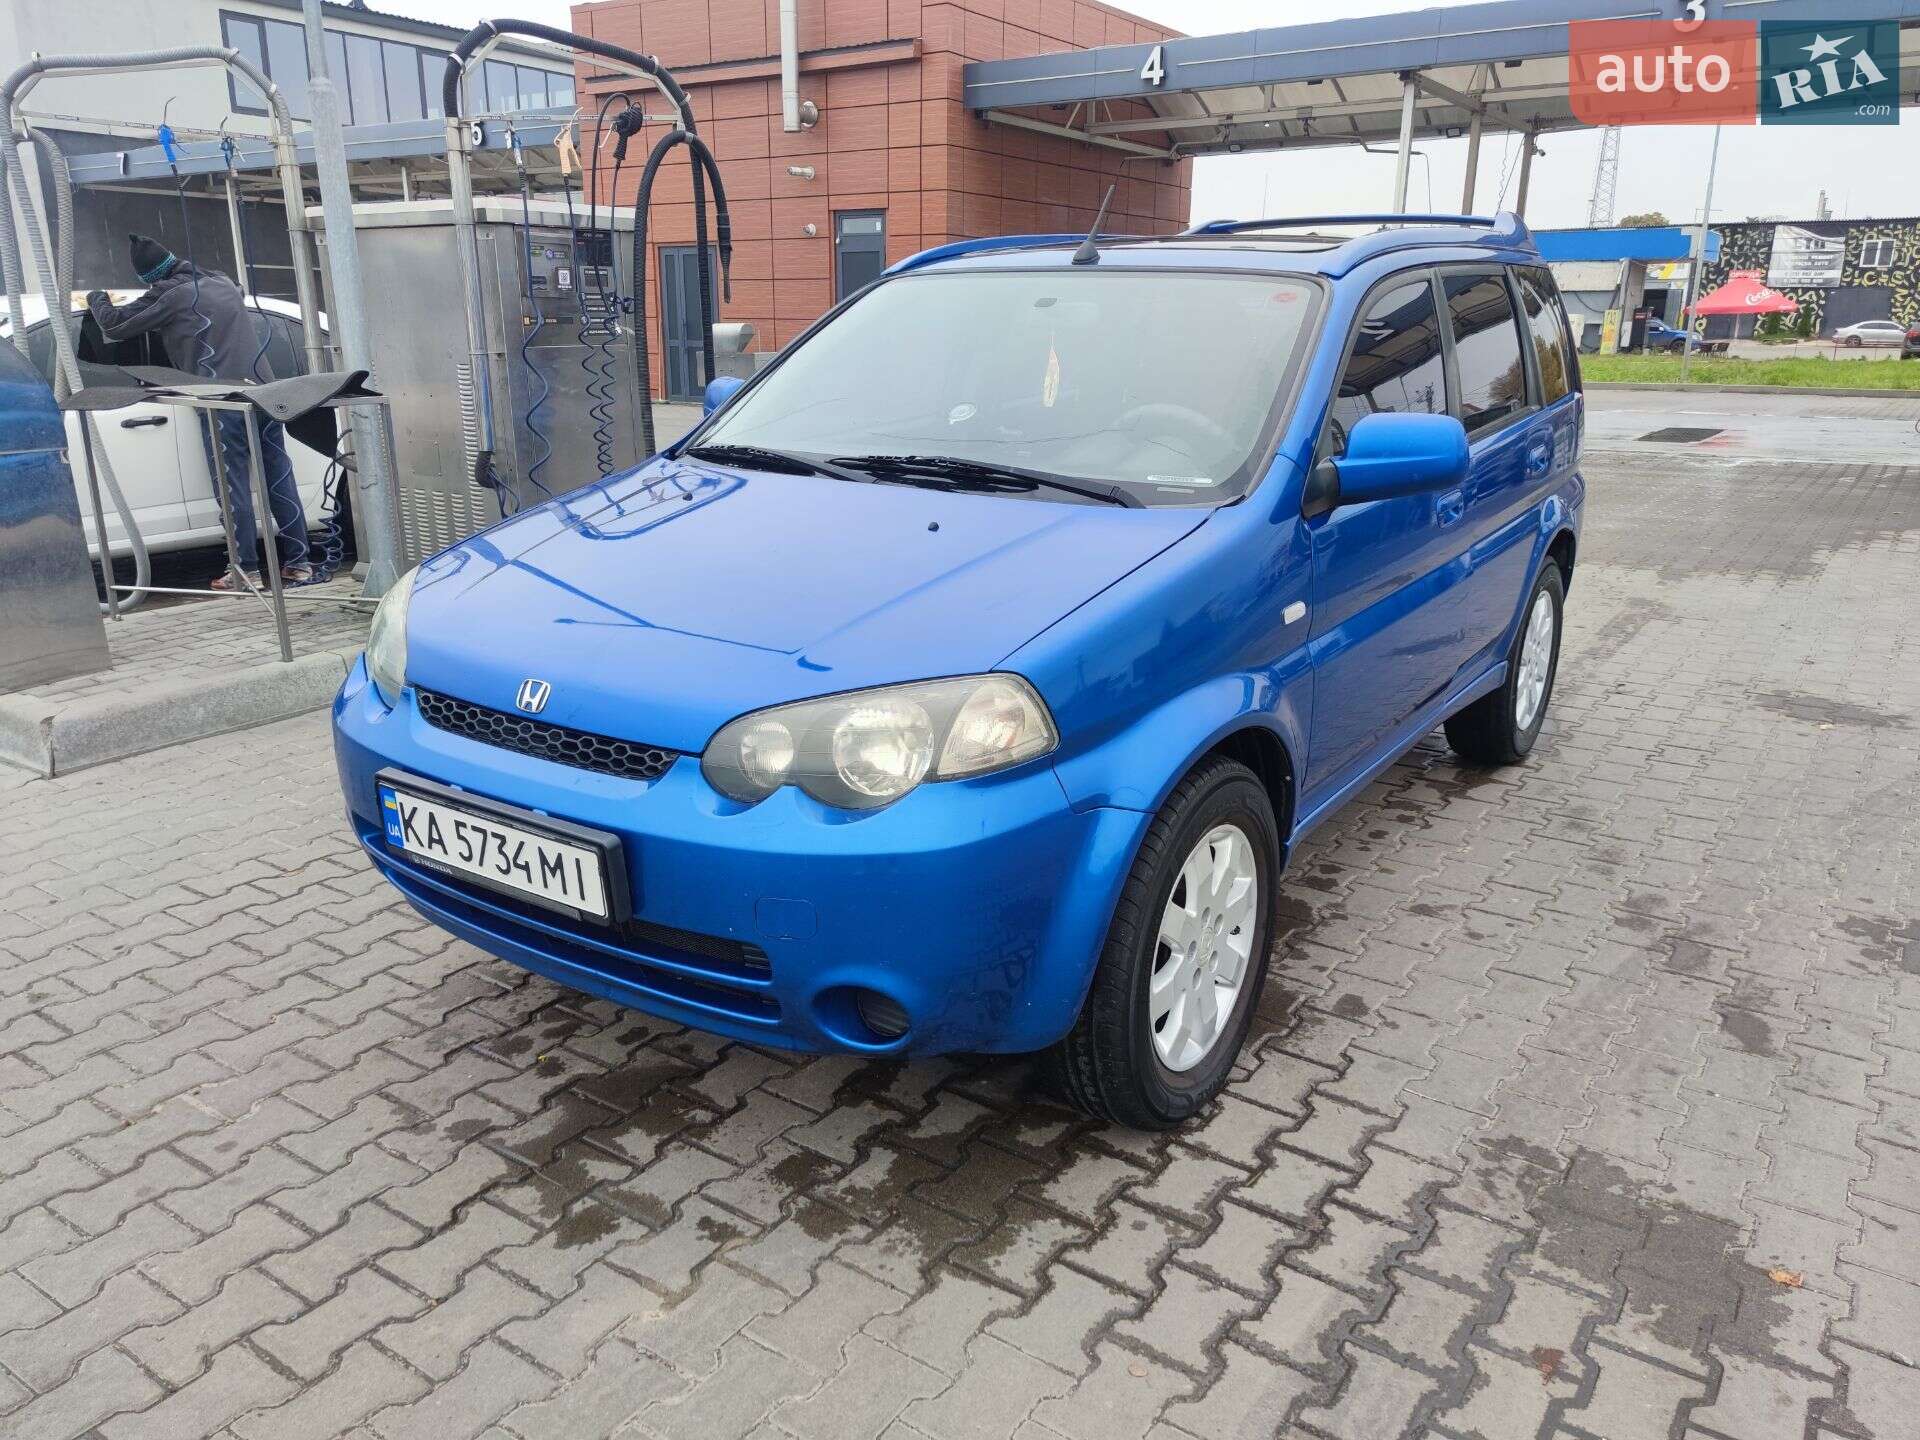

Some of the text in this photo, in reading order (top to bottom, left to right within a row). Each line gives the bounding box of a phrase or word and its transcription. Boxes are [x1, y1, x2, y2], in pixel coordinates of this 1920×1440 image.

[1673, 0, 1705, 32] 3
[1140, 45, 1164, 86] 4
[387, 822, 401, 838] UA
[453, 819, 533, 884] 5734
[537, 845, 586, 901] MI
